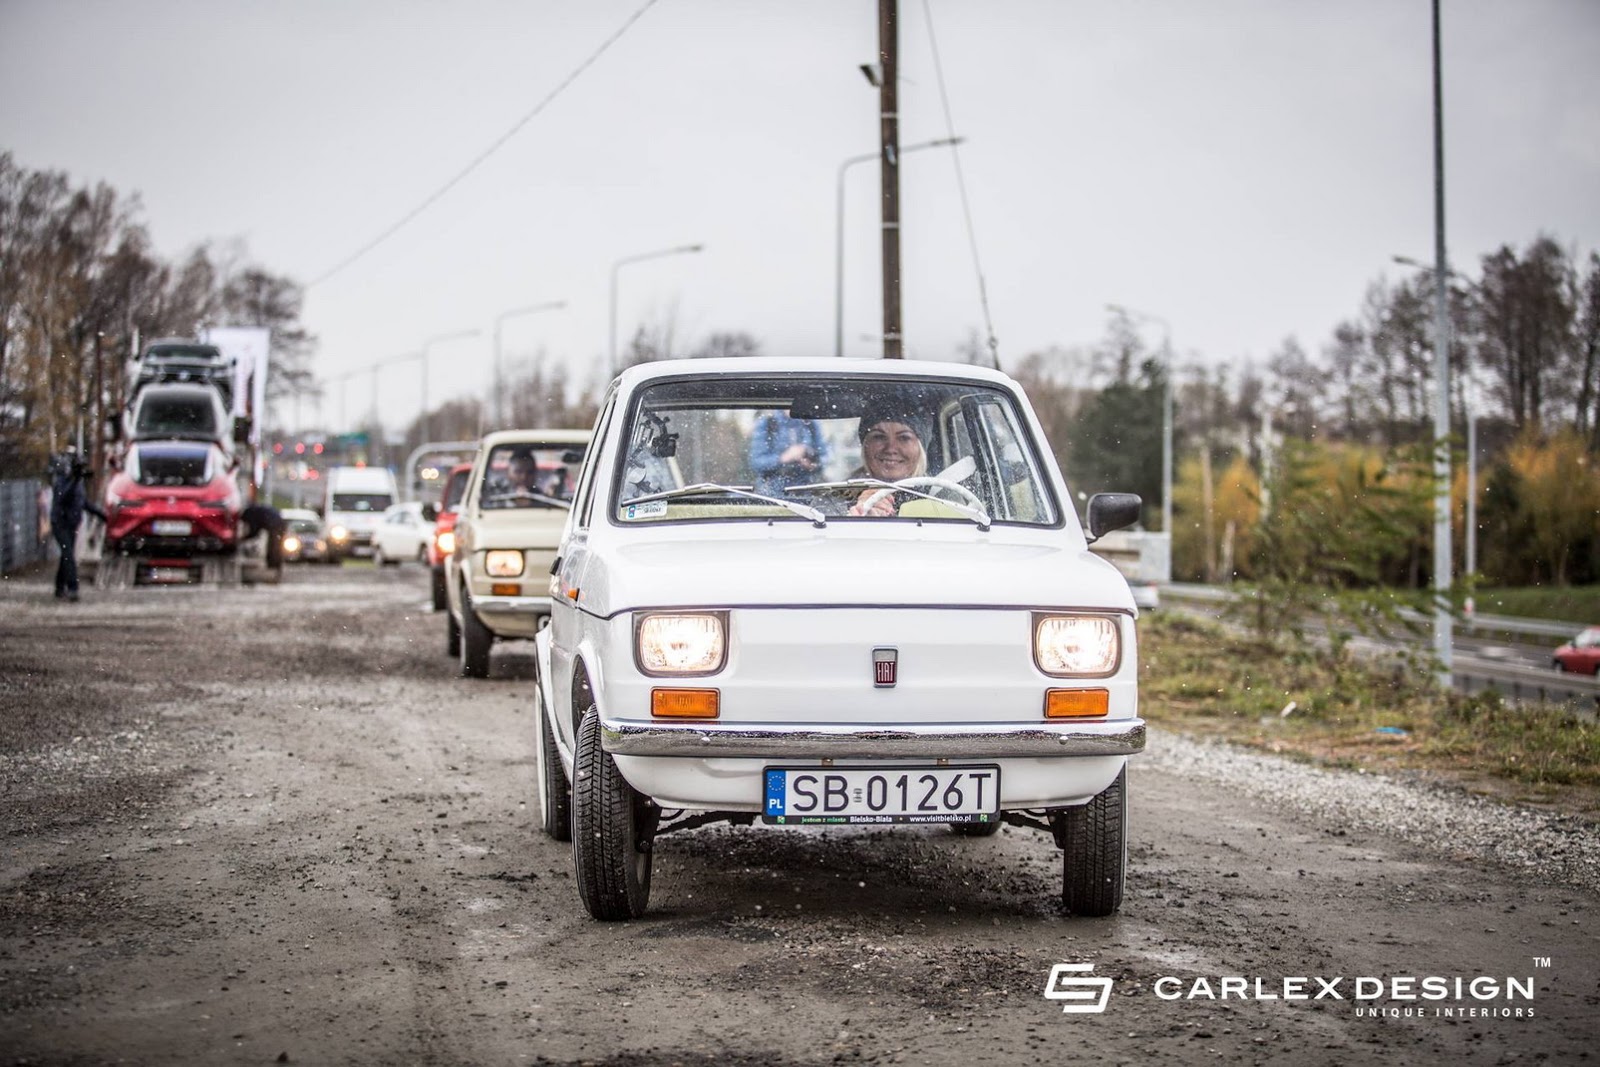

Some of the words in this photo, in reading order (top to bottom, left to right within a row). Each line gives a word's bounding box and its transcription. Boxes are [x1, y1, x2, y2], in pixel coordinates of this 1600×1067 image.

[877, 662, 894, 682] FIAT
[792, 774, 849, 812] SB
[866, 773, 991, 812] 0126T
[769, 798, 783, 809] PL
[909, 814, 972, 823] www.visitbielsko.pl
